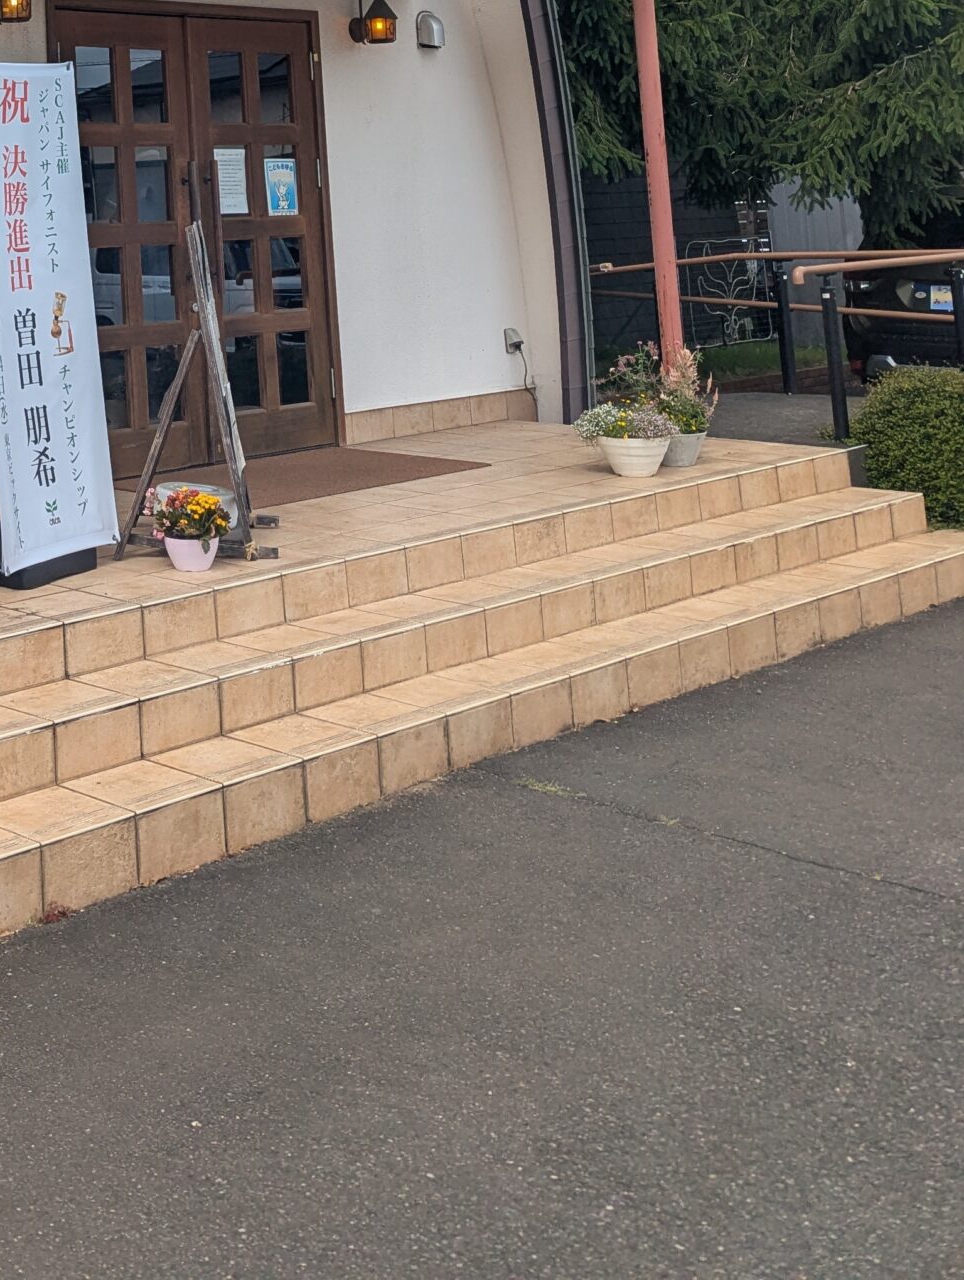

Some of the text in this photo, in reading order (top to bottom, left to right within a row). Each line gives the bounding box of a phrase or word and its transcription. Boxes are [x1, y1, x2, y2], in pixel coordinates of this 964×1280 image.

[54, 77, 70, 175] SCAJ主催
[2, 144, 33, 293] 決勝進出
[13, 307, 44, 390] 曽田
[24, 404, 57, 488] 朋希
[58, 364, 88, 517] チャンピオンシップ
